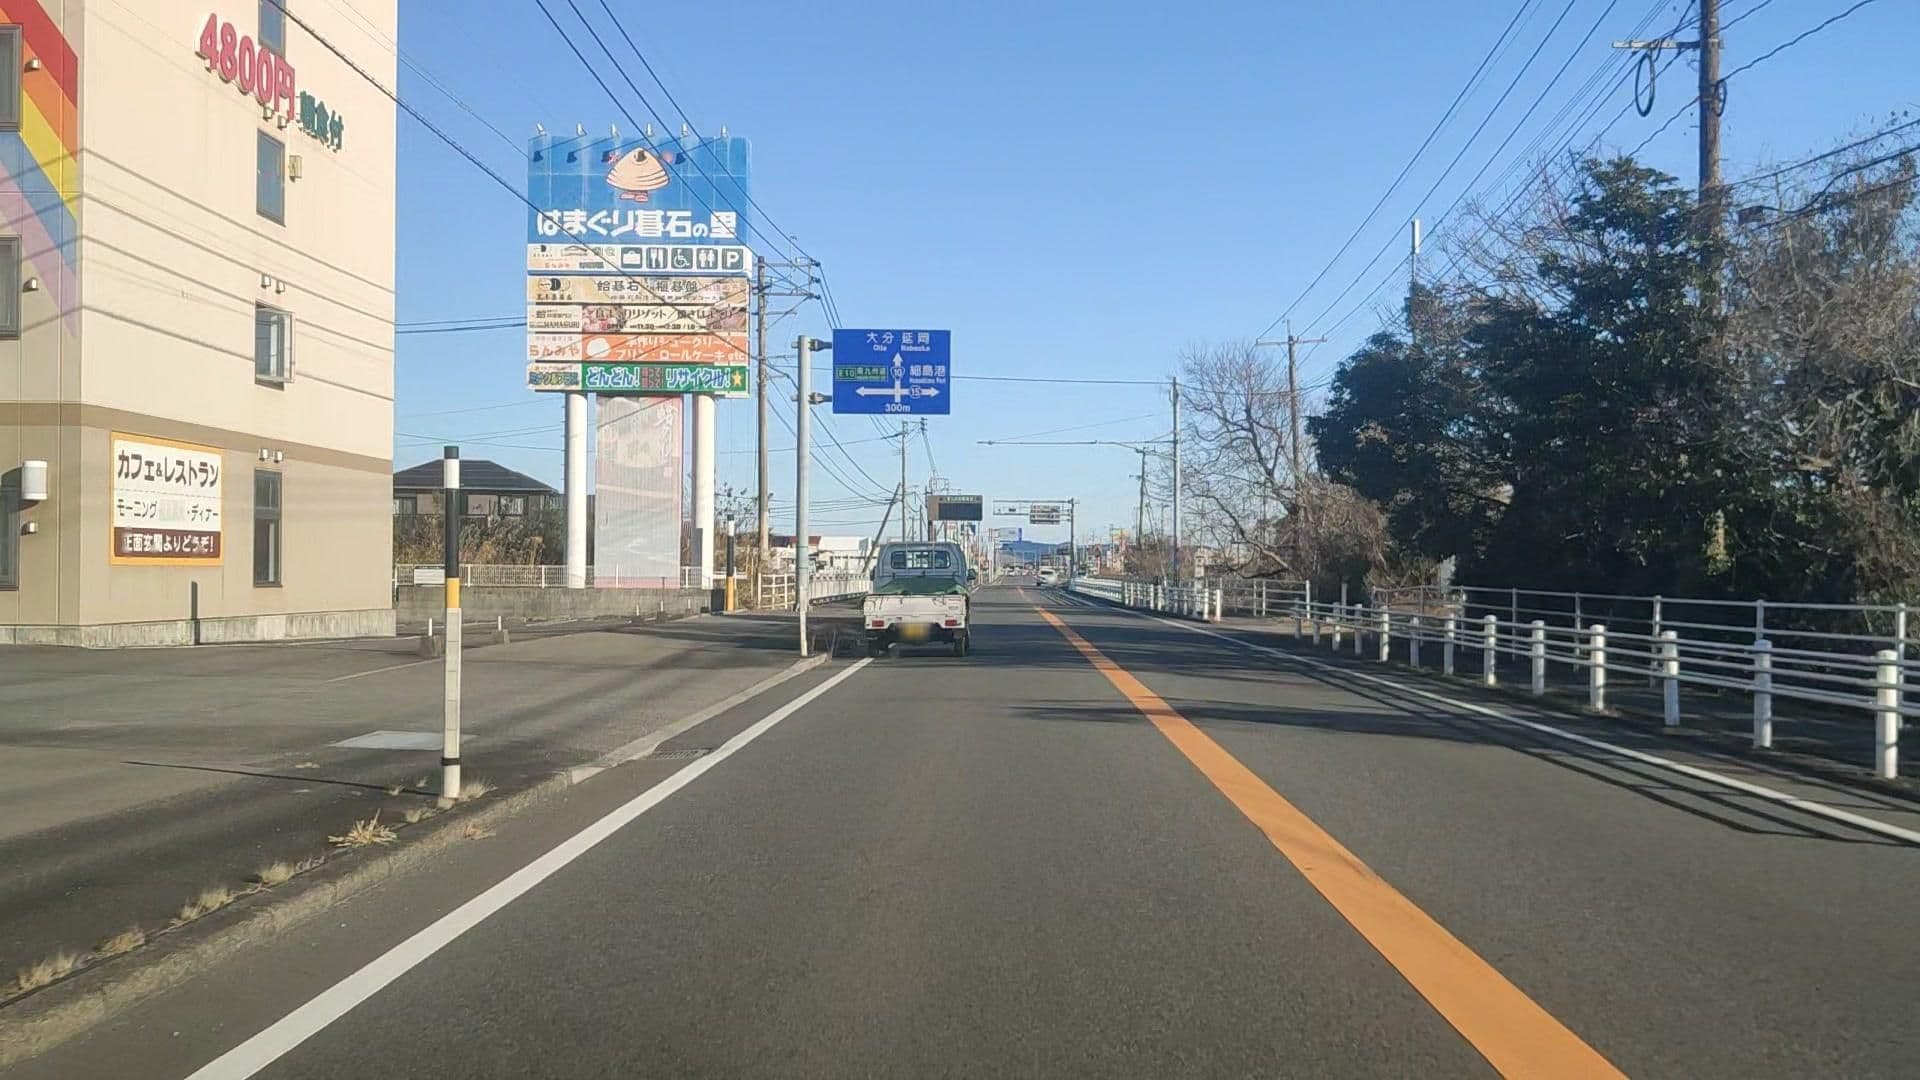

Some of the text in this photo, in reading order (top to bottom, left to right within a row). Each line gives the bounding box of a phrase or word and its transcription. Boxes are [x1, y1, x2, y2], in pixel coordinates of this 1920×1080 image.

[199, 13, 296, 124] 4800円
[537, 209, 737, 240] はまぐり碁石の里
[866, 332, 930, 345] 大分 延岡
[893, 368, 903, 377] 10
[884, 403, 911, 413] 300m
[117, 449, 219, 488] カフェ&レストラン
[116, 498, 158, 519] モーニング
